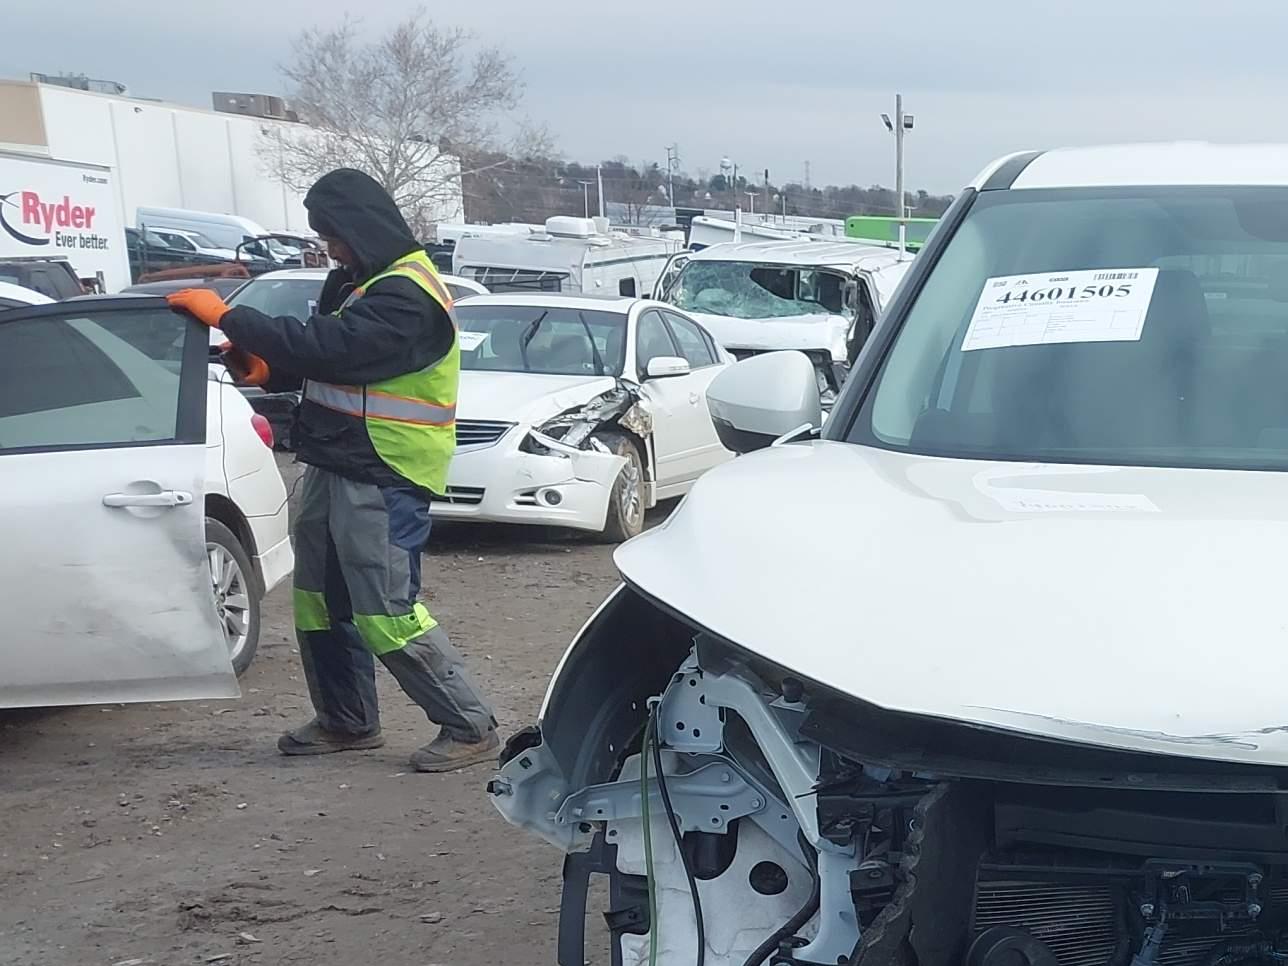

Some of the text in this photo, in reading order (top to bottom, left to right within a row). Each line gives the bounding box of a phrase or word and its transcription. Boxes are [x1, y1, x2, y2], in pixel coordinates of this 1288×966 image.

[22, 191, 95, 233] Ryder
[55, 231, 109, 250] Ever better.
[996, 284, 1132, 304] 44601505
